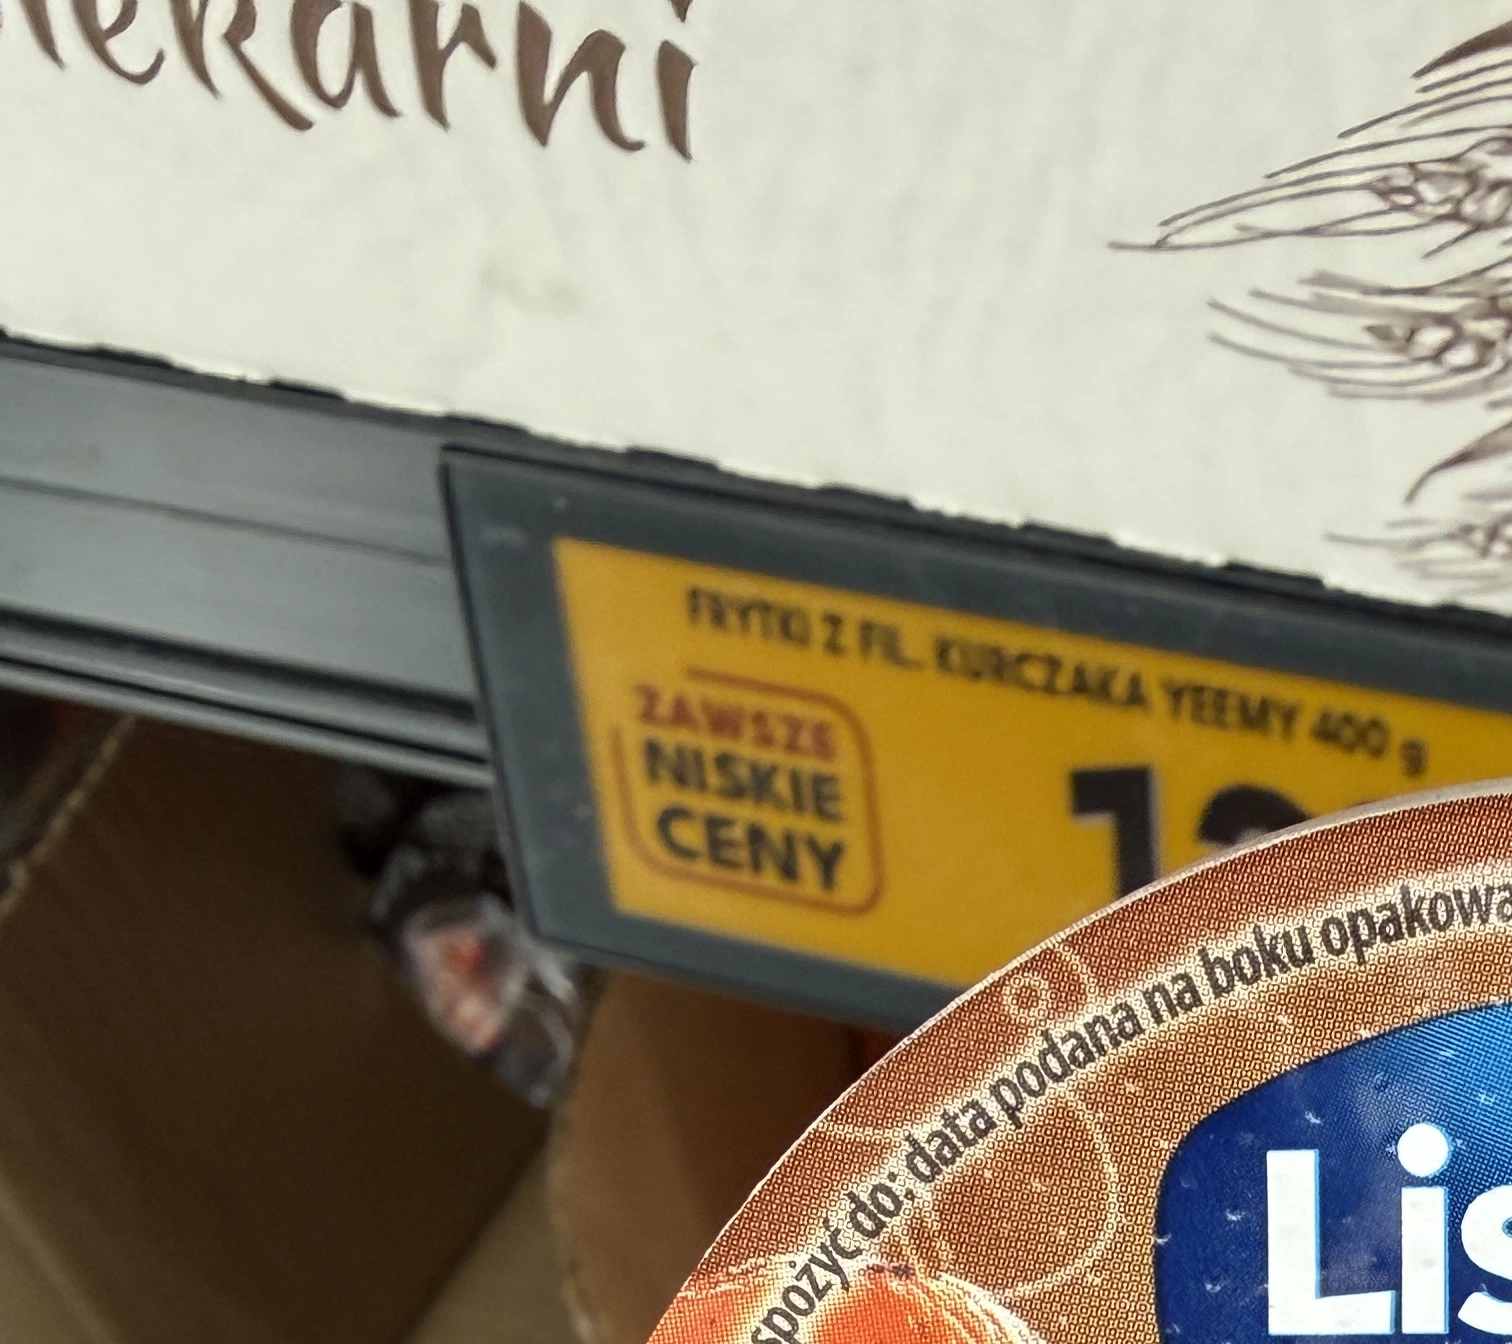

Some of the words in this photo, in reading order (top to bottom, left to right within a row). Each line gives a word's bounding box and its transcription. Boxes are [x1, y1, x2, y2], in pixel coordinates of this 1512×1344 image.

[632, 682, 839, 762] ZAWSZE
[935, 634, 1149, 708] KURCZAKA
[1164, 681, 1302, 741] YEEMY
[1310, 703, 1391, 758] 400
[643, 738, 845, 822] NISKIE
[656, 804, 847, 892] CENY
[1070, 763, 1315, 905] 1
[847, 1170, 915, 1240] do:
[903, 1098, 1001, 1186] data
[988, 998, 1145, 1127] podana
[1147, 969, 1207, 1026] na
[1202, 921, 1316, 999] boku
